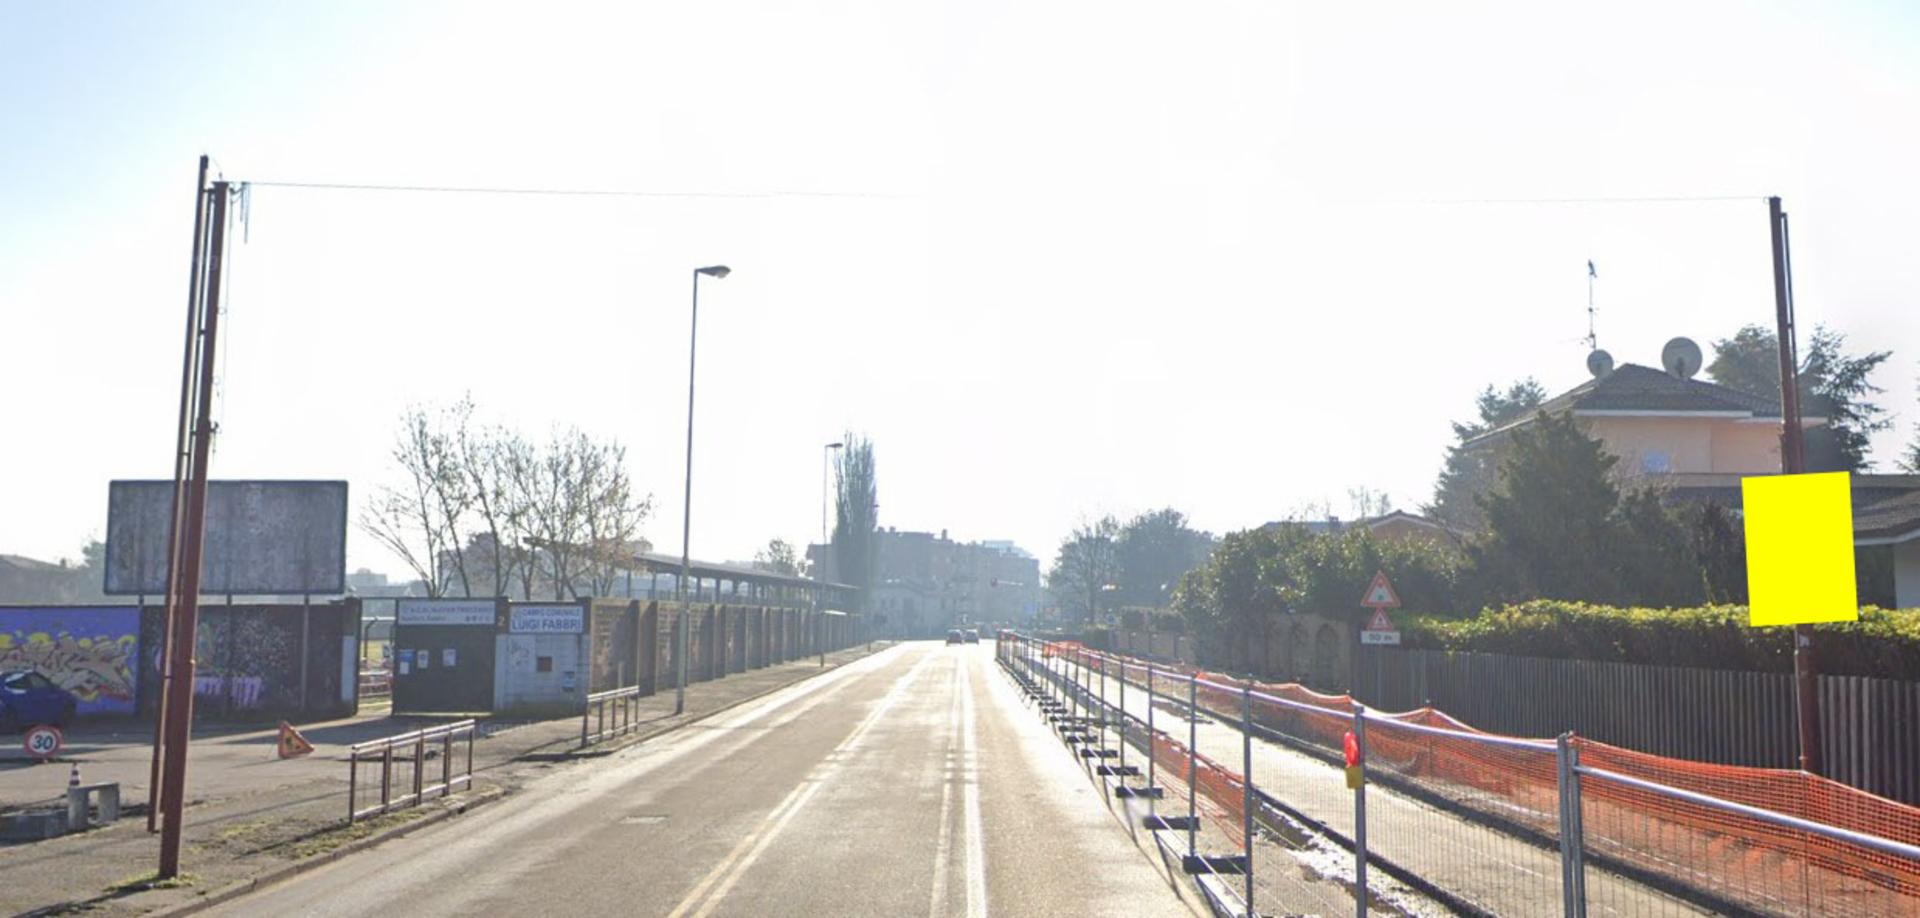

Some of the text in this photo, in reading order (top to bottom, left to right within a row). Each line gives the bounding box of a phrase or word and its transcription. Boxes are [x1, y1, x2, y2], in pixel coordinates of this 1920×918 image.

[511, 618, 582, 631] LUIGI FABBRI
[32, 734, 54, 750] 30
